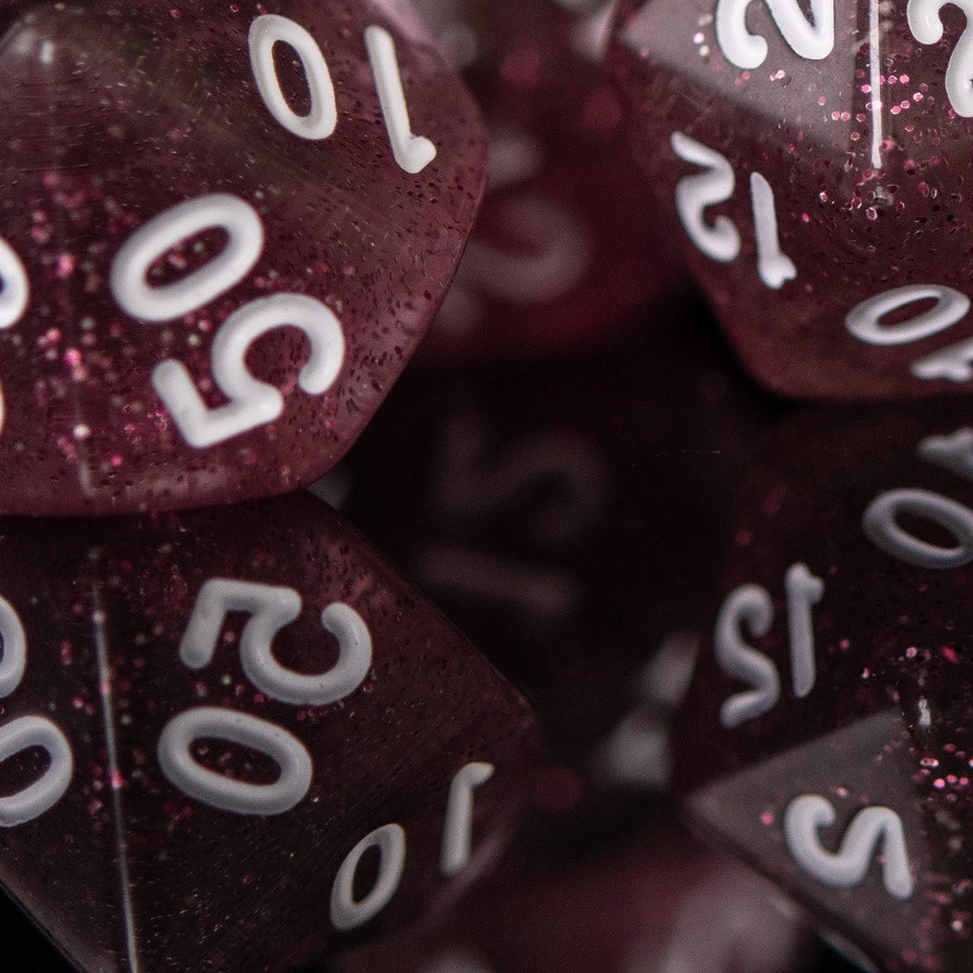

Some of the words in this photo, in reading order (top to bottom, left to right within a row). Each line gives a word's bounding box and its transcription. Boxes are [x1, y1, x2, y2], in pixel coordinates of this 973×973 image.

[247, 13, 438, 175] 10
[671, 132, 797, 289] 12
[113, 194, 346, 449] 50
